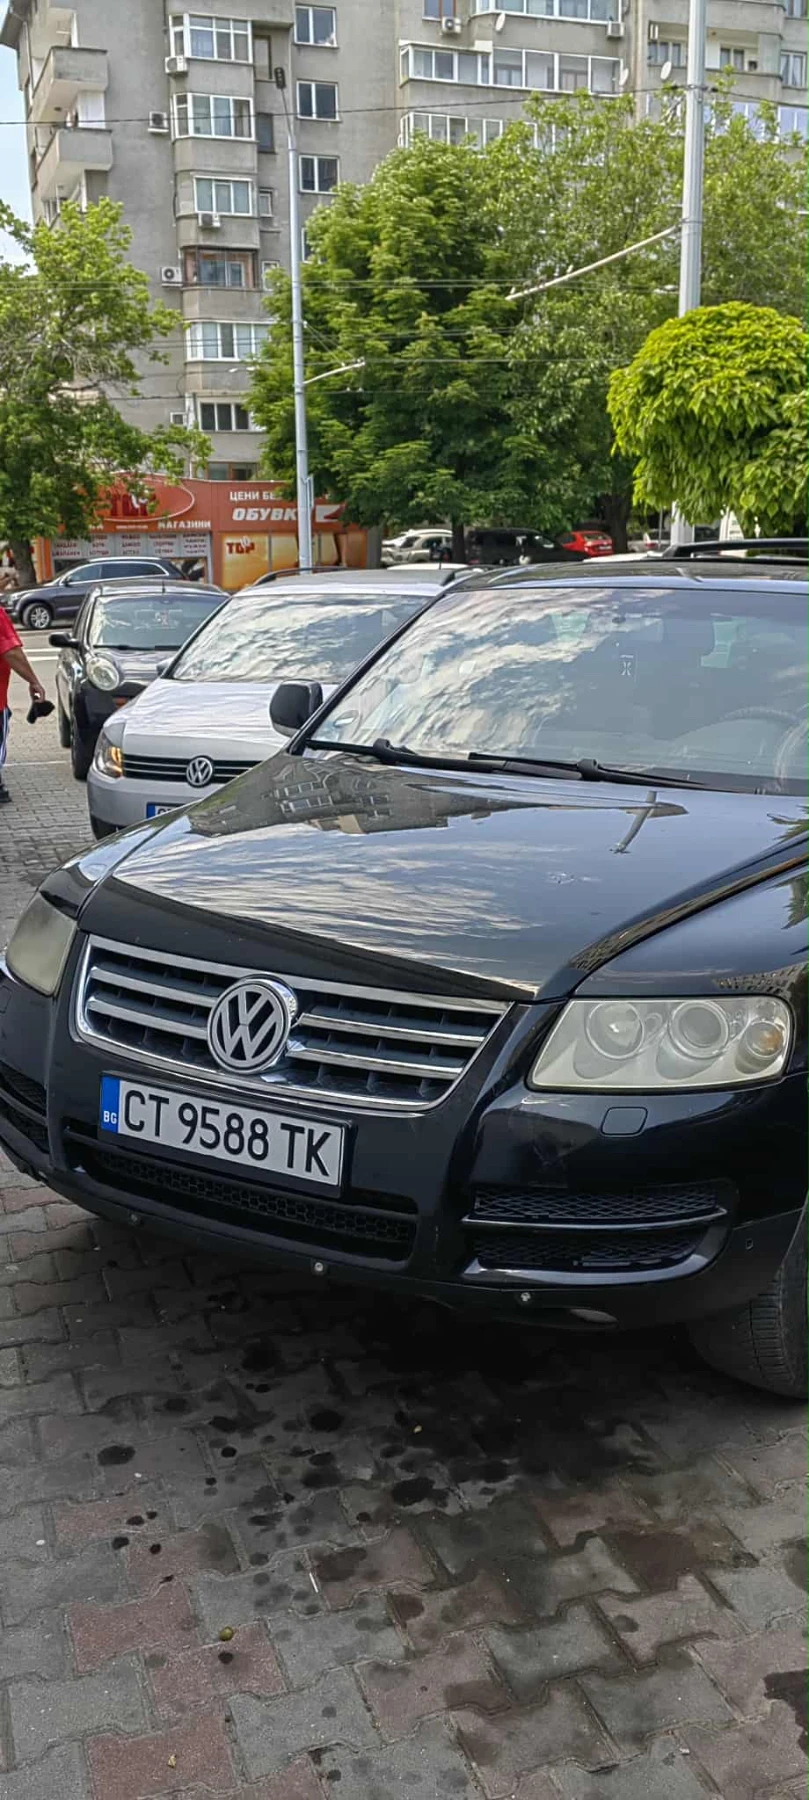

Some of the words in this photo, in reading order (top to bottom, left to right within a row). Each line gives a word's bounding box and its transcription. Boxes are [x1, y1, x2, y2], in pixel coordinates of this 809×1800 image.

[229, 491, 260, 502] ЦЕНИ
[232, 508, 297, 521] ОБУВК
[103, 1110, 117, 1124] BG
[124, 1090, 169, 1137] CT
[178, 1103, 269, 1160] 9588
[281, 1123, 331, 1177] TK
